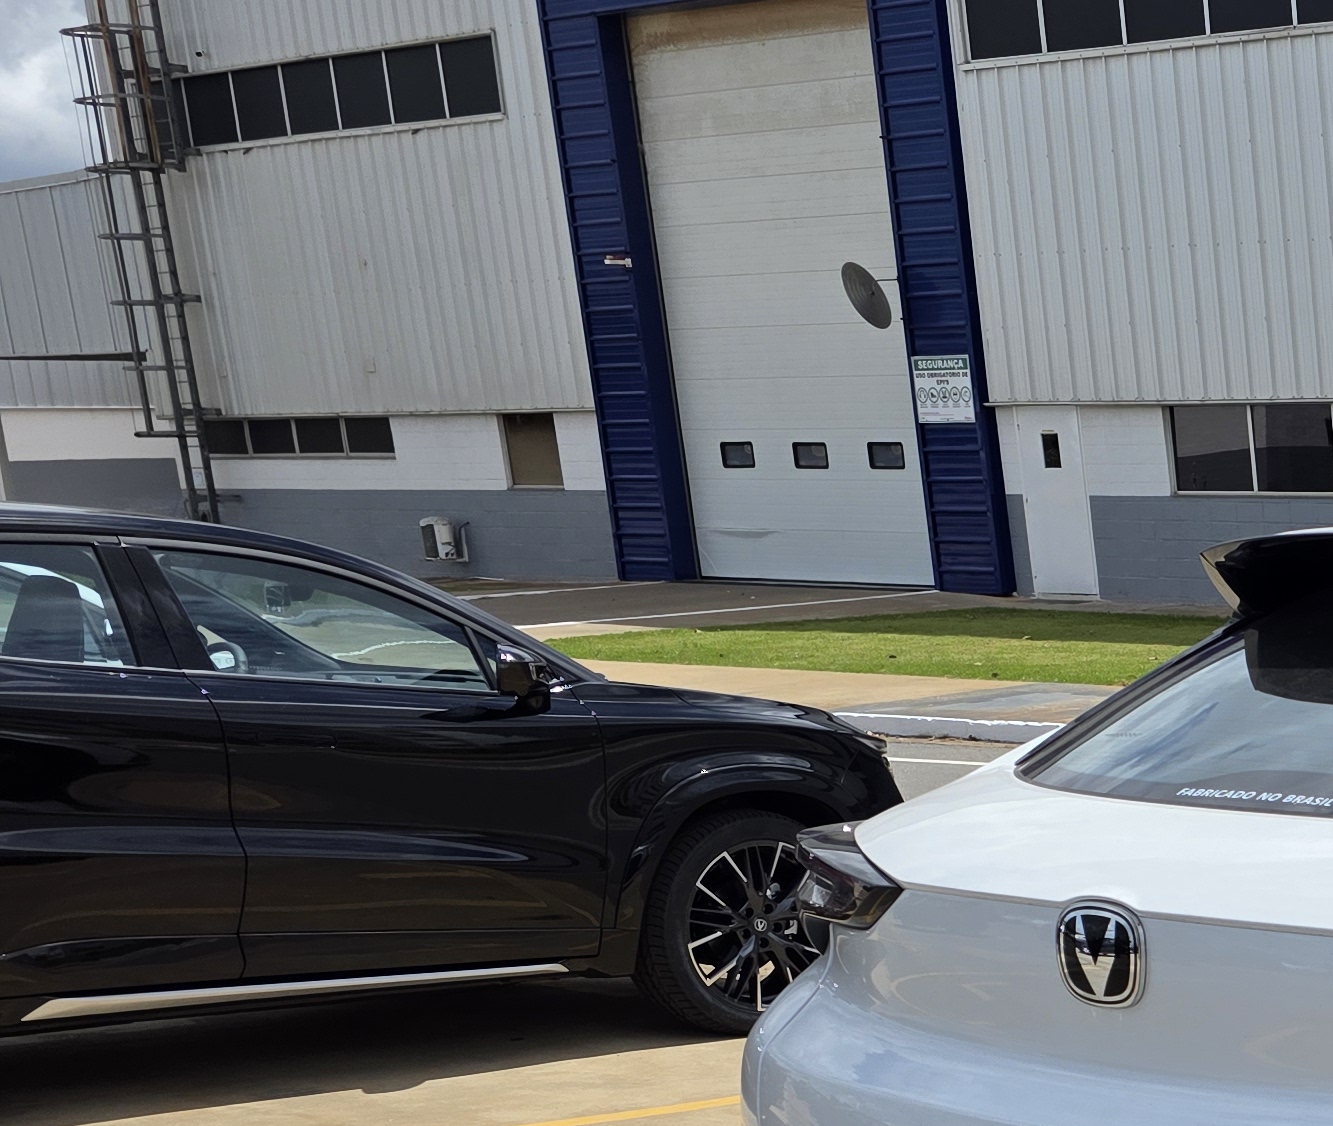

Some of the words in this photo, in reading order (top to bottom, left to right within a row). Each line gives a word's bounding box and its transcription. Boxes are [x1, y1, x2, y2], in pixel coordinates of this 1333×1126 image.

[918, 360, 964, 369] SEGURANÇA
[1176, 787, 1257, 800] FABRICADO
[1258, 792, 1283, 802] NO
